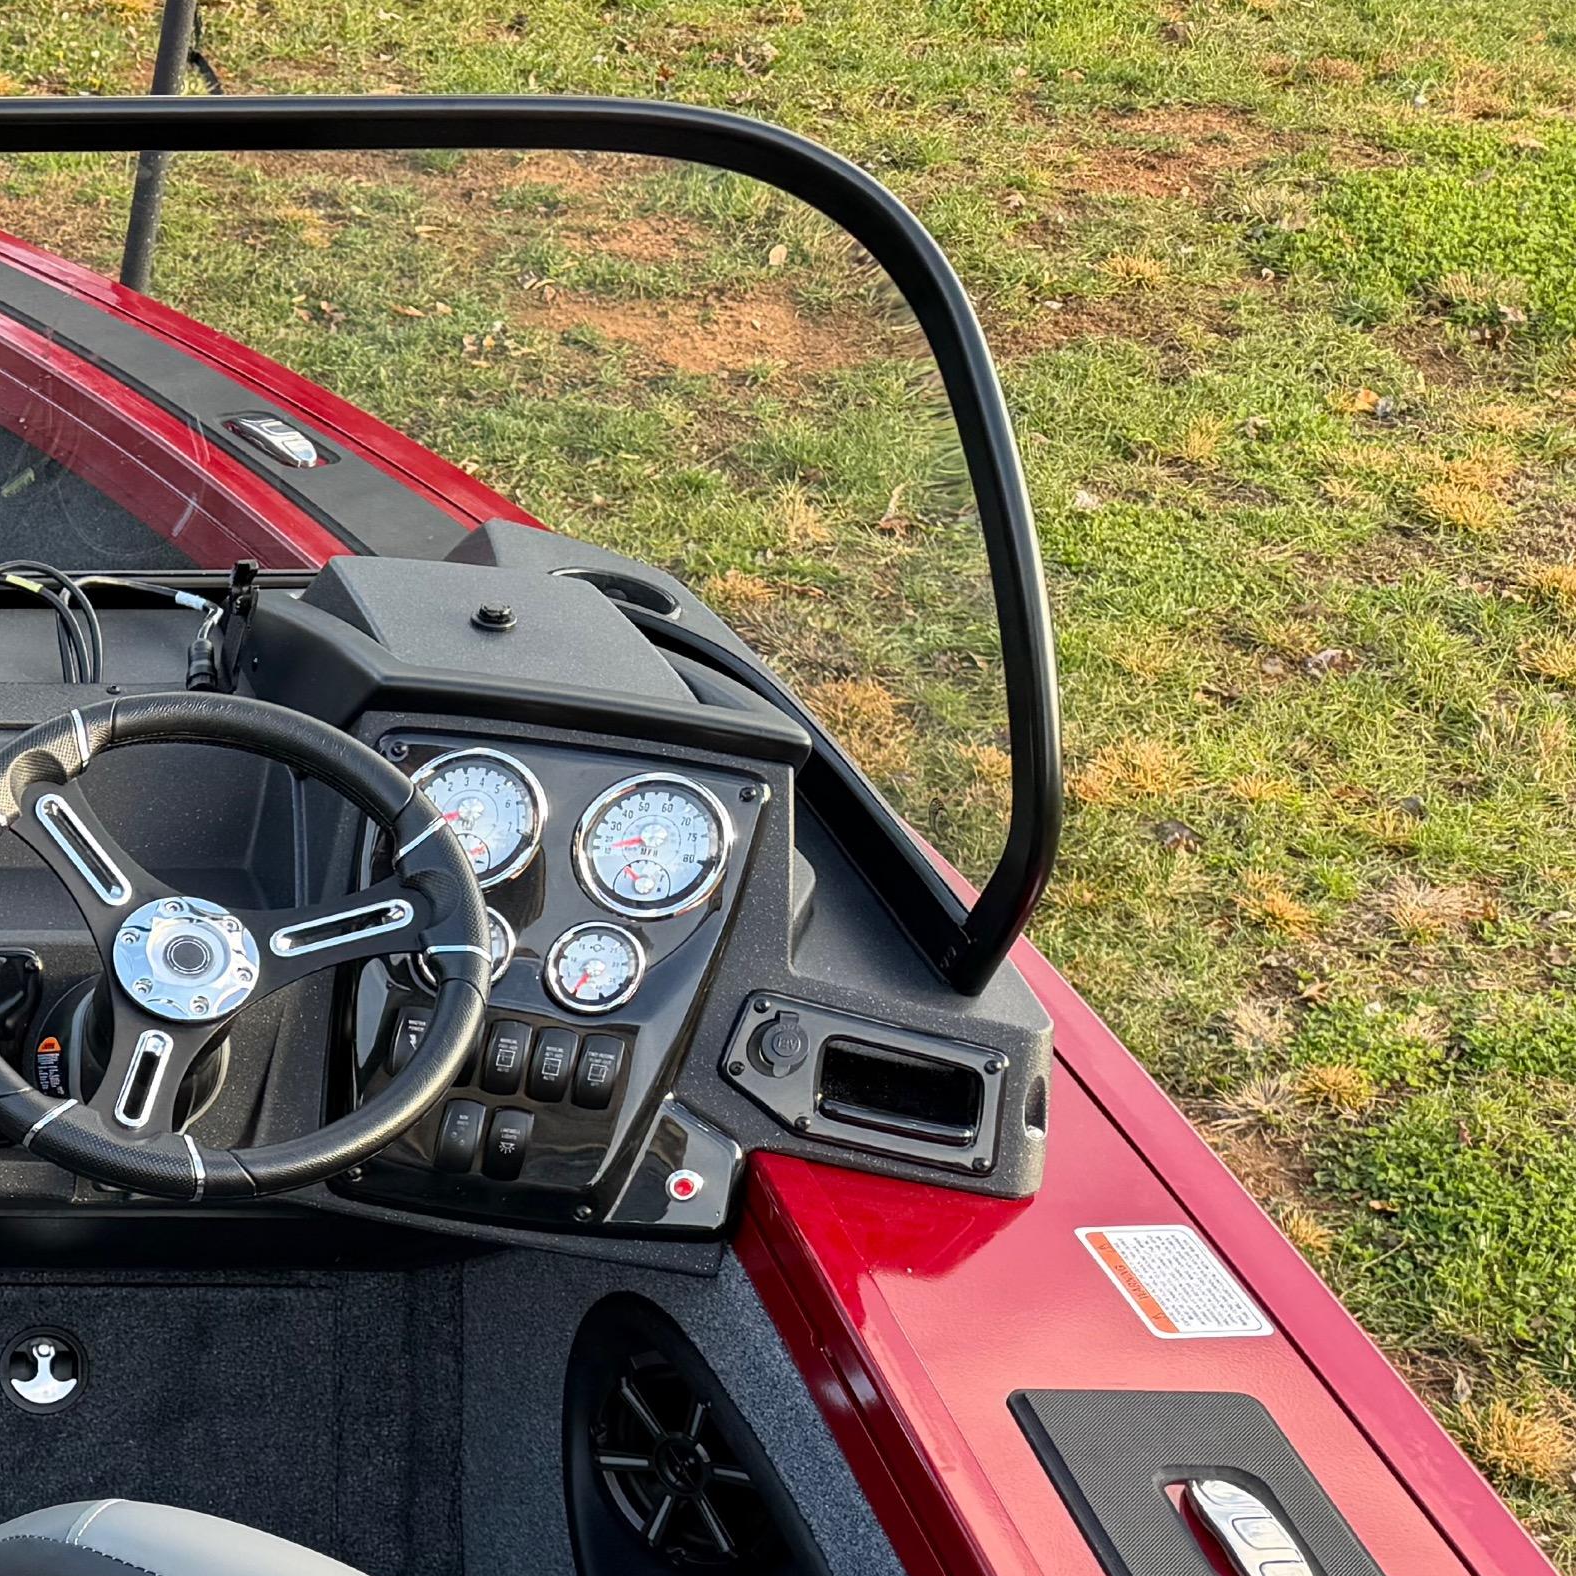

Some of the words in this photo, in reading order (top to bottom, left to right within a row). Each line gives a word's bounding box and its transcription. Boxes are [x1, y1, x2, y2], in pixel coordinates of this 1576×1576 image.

[447, 781, 453, 792] 2
[464, 776, 470, 787] 3
[479, 777, 485, 787] 4
[494, 783, 501, 794] 5
[505, 799, 511, 809] 6
[638, 801, 650, 812] 50
[661, 802, 674, 813] 60
[622, 809, 634, 819] 40
[610, 821, 622, 832] 30
[681, 816, 691, 827] 70
[683, 853, 695, 864] 80
